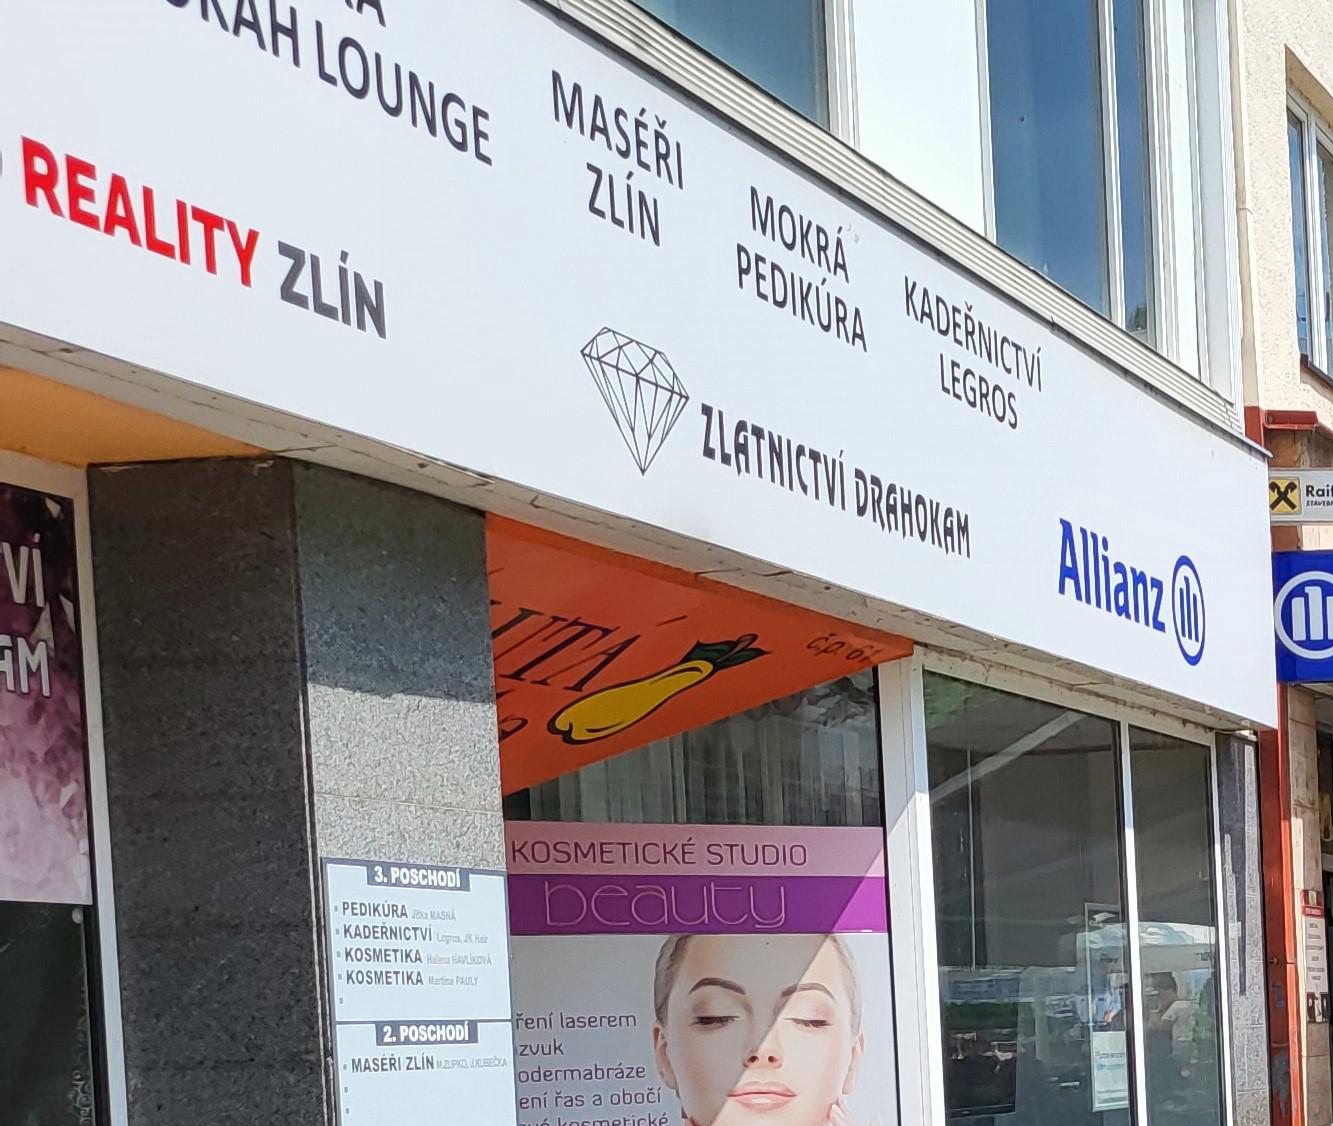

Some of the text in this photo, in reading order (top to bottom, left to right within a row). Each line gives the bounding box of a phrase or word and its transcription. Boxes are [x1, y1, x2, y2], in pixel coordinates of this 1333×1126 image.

[316, 20, 493, 166] LOUNGE
[550, 69, 684, 190] MASÉŘI
[586, 162, 661, 247] ZLÍN
[21, 135, 387, 340] REALITY ZLÍN
[750, 185, 849, 284] MOKRÁ
[736, 243, 868, 353] PEDIKÚRA
[904, 275, 1043, 394] KADEŘNICTVÍ
[940, 353, 1018, 431] LEGROS
[700, 403, 971, 559] ZLATNICTVÍ DRAHOKAM
[1058, 517, 1165, 633] Allianz
[511, 836, 808, 866] KOSMETICKÉ STUDIO
[374, 865, 461, 888] 3. POSCHODÍ
[342, 900, 408, 919] PEDIKÚRA
[544, 880, 786, 929] beauty
[343, 922, 432, 942] KADEŘNICTVÍ
[344, 947, 423, 964] KOSMETIKA
[346, 969, 424, 986] KOSMETIKA
[383, 1020, 469, 1043] 2. POSCHODÍ
[560, 1012, 637, 1029] laserem
[519, 1038, 565, 1056] zvuk
[351, 1053, 401, 1073] MASÉŘI
[405, 1052, 435, 1071] ZLÍN
[518, 1062, 647, 1083] odermabráze
[519, 1086, 662, 1109] ení řas a obočí
